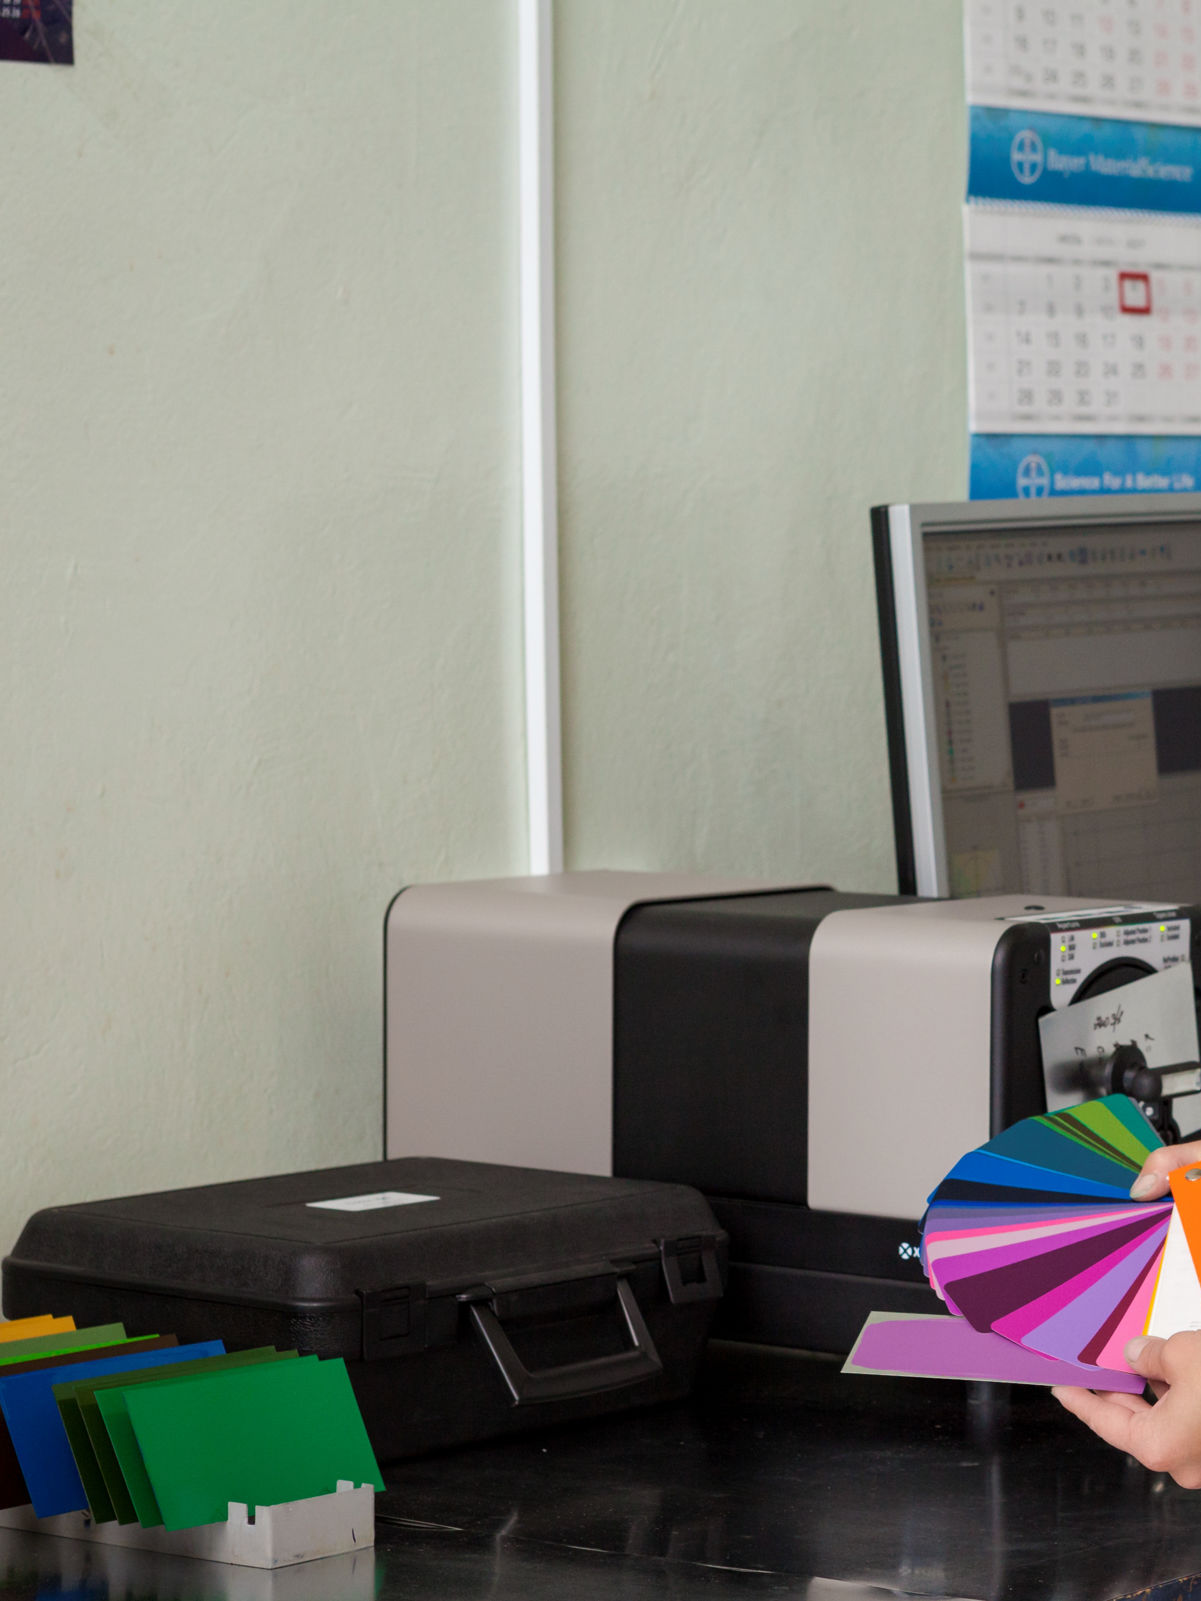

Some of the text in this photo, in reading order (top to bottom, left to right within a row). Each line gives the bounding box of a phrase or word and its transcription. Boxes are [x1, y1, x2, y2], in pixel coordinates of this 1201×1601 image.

[1047, 146, 1086, 178] Bayer
[1054, 472, 1194, 490] Science For A Better Life
